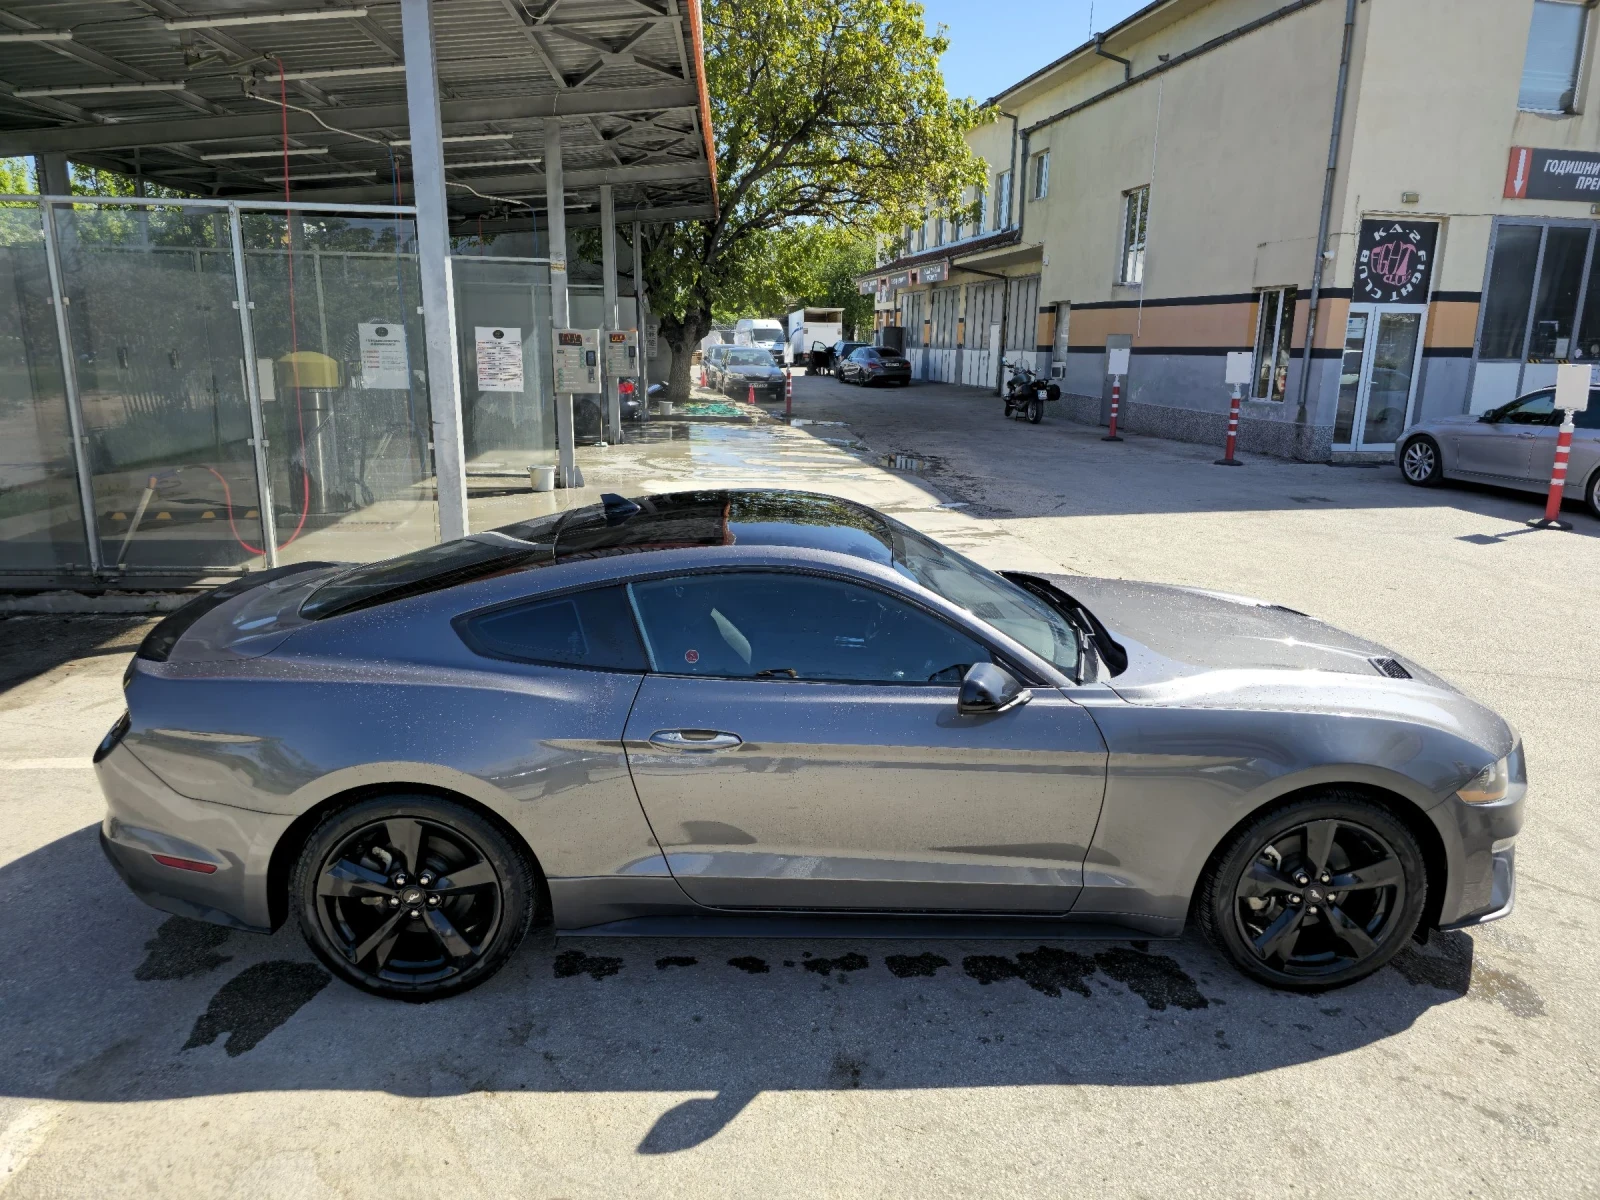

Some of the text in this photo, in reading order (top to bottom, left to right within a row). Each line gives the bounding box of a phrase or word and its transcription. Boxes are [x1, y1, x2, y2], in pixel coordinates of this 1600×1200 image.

[1543, 159, 1600, 176] ГОДИШНИ
[1359, 249, 1382, 299] CLUB
[1371, 240, 1417, 275] FIGHT
[1390, 250, 1427, 301] FIGHT
